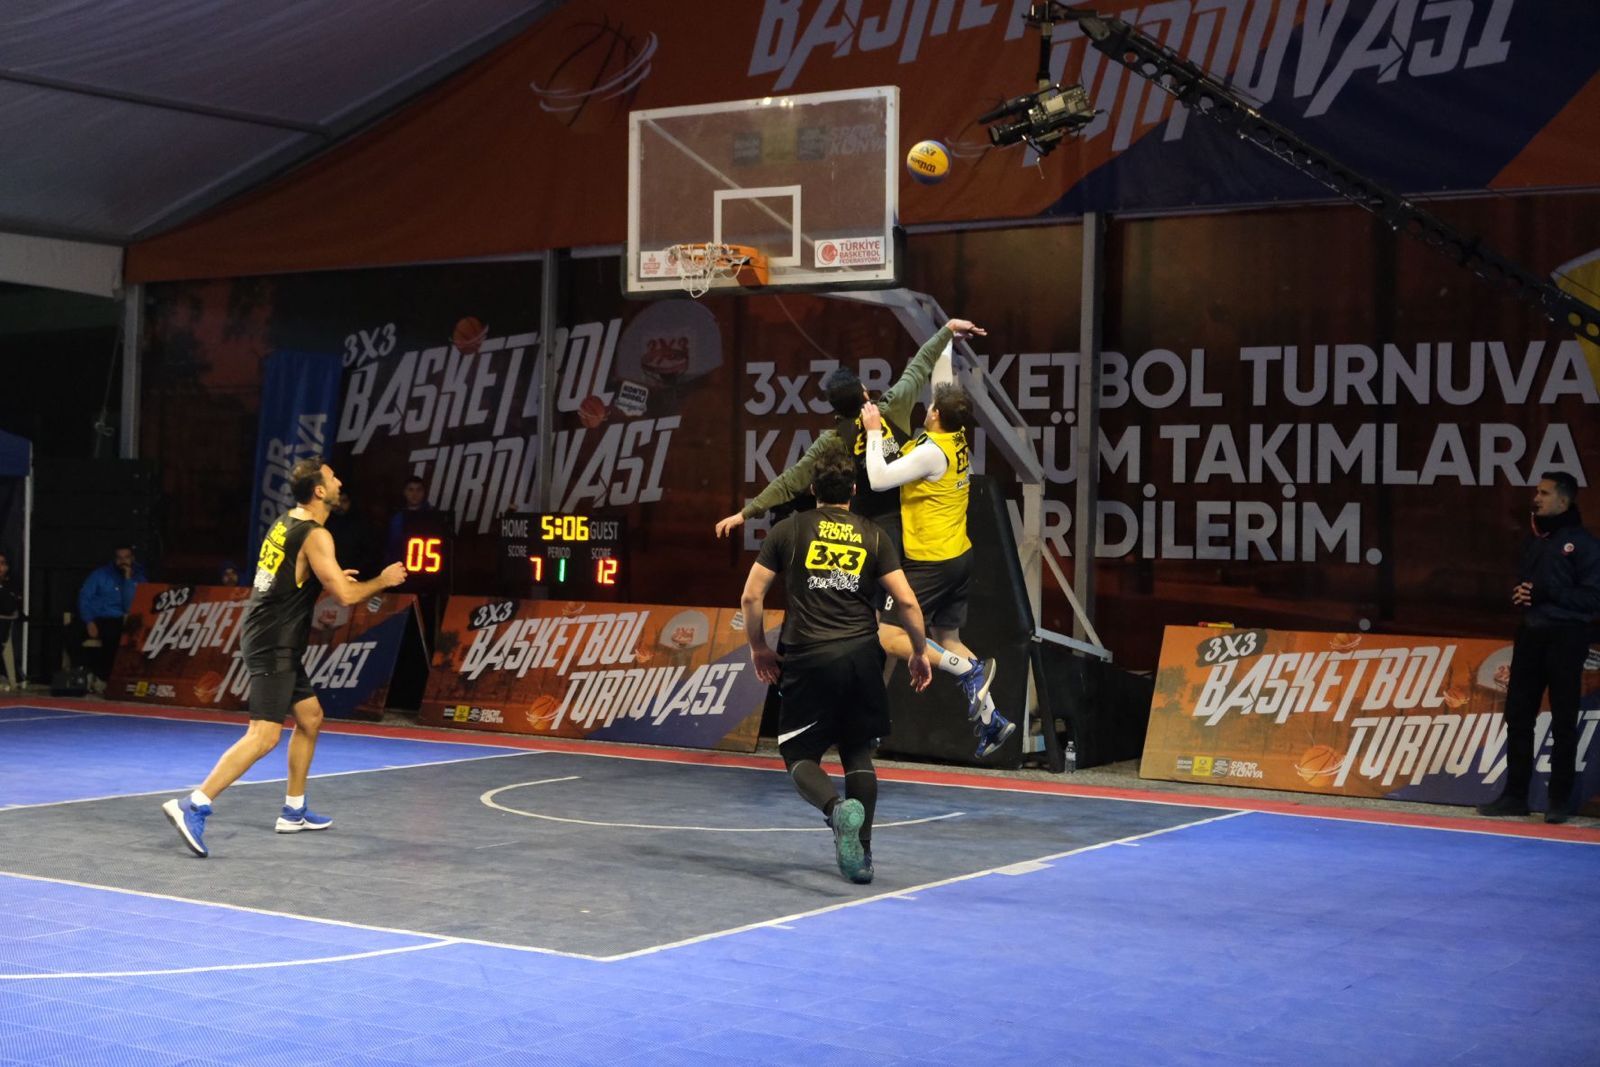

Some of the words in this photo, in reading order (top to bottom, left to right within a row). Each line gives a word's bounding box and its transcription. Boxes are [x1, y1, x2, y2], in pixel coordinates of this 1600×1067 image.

[839, 239, 881, 251] TÜRKİYE
[839, 249, 881, 258] BASKETBOL
[337, 318, 623, 455] BASKETBOL
[858, 348, 1223, 409] BKETBOL
[1240, 340, 1600, 406] TURNUVA
[1160, 423, 1588, 487] TAKIMLARA
[501, 519, 529, 538] HOME
[541, 515, 589, 541] 5:06
[590, 521, 619, 540] GUEST
[818, 528, 863, 544] KONYA
[1095, 483, 1383, 566] DİLERİM.
[406, 537, 441, 573] 05
[507, 544, 528, 558] SCORE
[547, 546, 571, 559] PERIOD
[811, 544, 862, 571] 3x3
[530, 556, 542, 582] 7
[559, 558, 566, 582] 1
[597, 558, 618, 584] 12
[142, 599, 251, 660] BASKET
[473, 601, 513, 627] 3X3
[458, 610, 651, 680] BASKETBOL
[1204, 632, 1257, 662] 3X3
[214, 641, 378, 702] TUVASI
[1192, 645, 1457, 726] BASKETBOL
[550, 662, 746, 730] TURNUVASI
